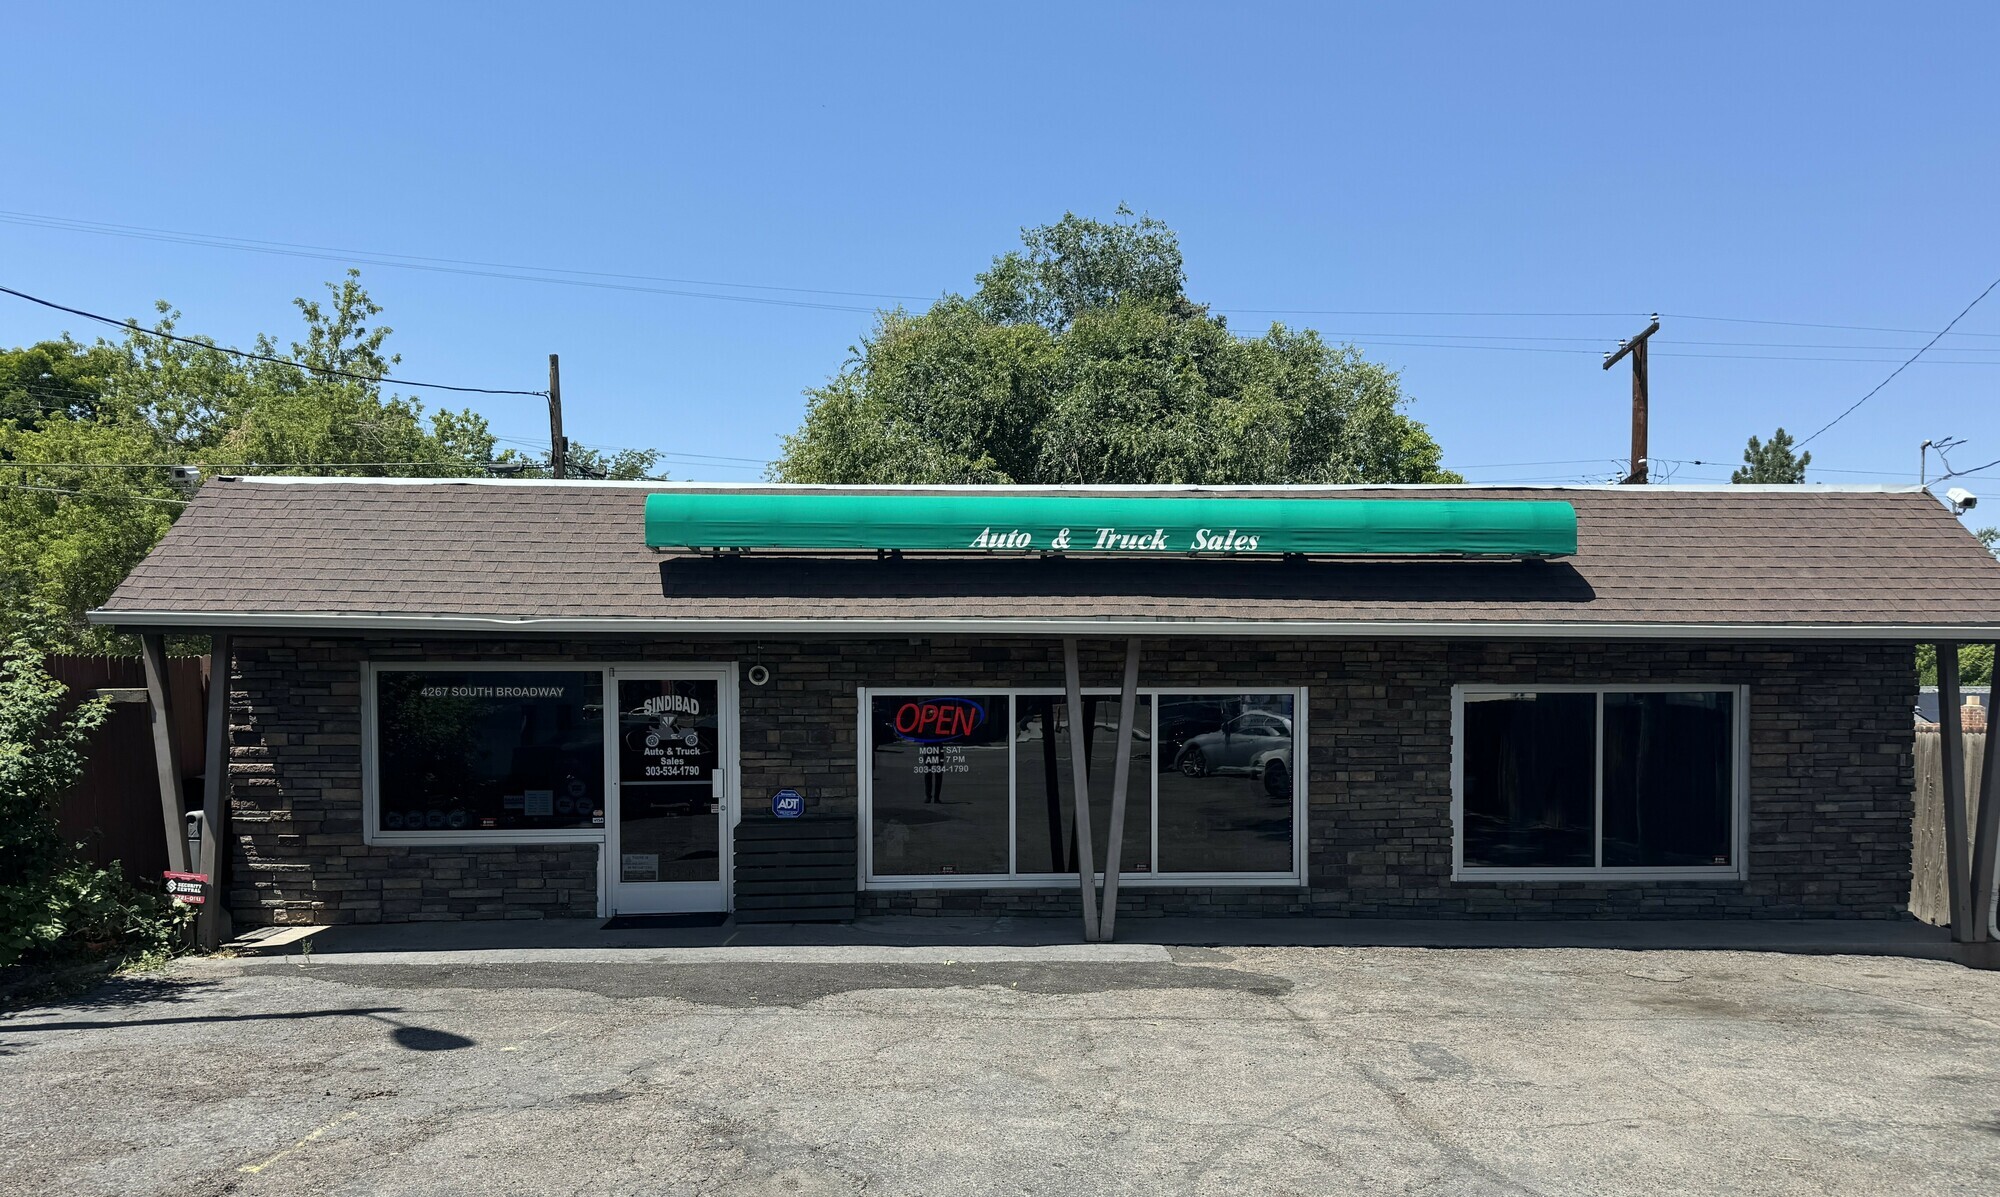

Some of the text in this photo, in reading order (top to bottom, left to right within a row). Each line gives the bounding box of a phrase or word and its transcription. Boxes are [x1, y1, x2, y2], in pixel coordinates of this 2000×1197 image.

[968, 526, 1261, 551] Auto & Truck Sales
[420, 687, 565, 697] 4267 SOUTH BROADWAY
[643, 695, 700, 715] SINDIBAD
[895, 703, 977, 737] OPEN
[643, 747, 701, 756] Auto & Truck
[919, 746, 940, 754] MON
[946, 746, 962, 754] SAT
[660, 757, 685, 765] Sales
[918, 756, 924, 764] 9
[925, 756, 940, 764] AM
[952, 755, 966, 763] PM
[645, 765, 700, 776] 303-534-1790
[913, 765, 969, 774] 303-534-1790
[777, 798, 799, 809] ADT
